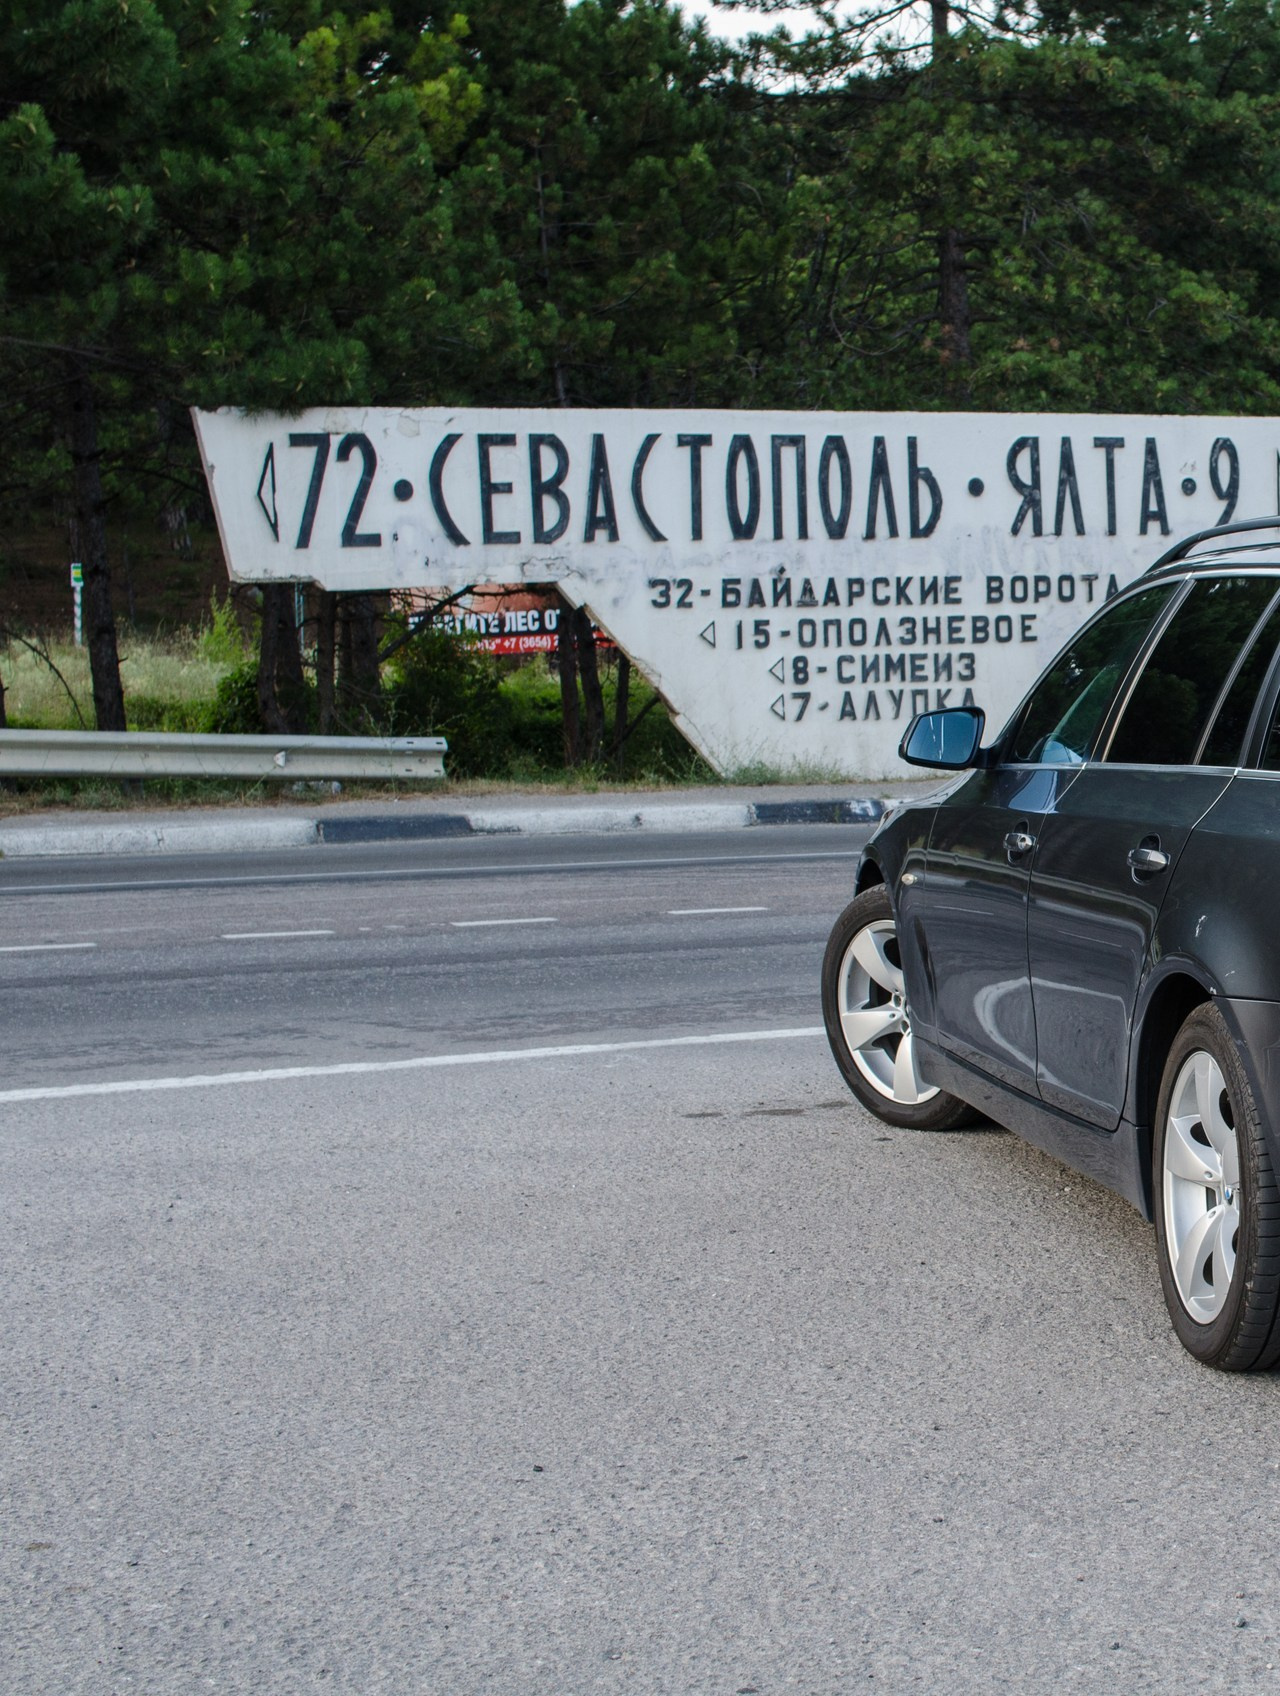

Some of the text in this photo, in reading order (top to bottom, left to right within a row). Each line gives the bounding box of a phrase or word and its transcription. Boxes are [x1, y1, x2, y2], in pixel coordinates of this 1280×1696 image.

[288, 432, 1240, 549] 72 СЕВАСТОПОЛЬ ЯЛТА 9
[985, 573, 1120, 604] ВОРОТА
[503, 609, 541, 633] ЛЕС
[544, 608, 560, 631] О
